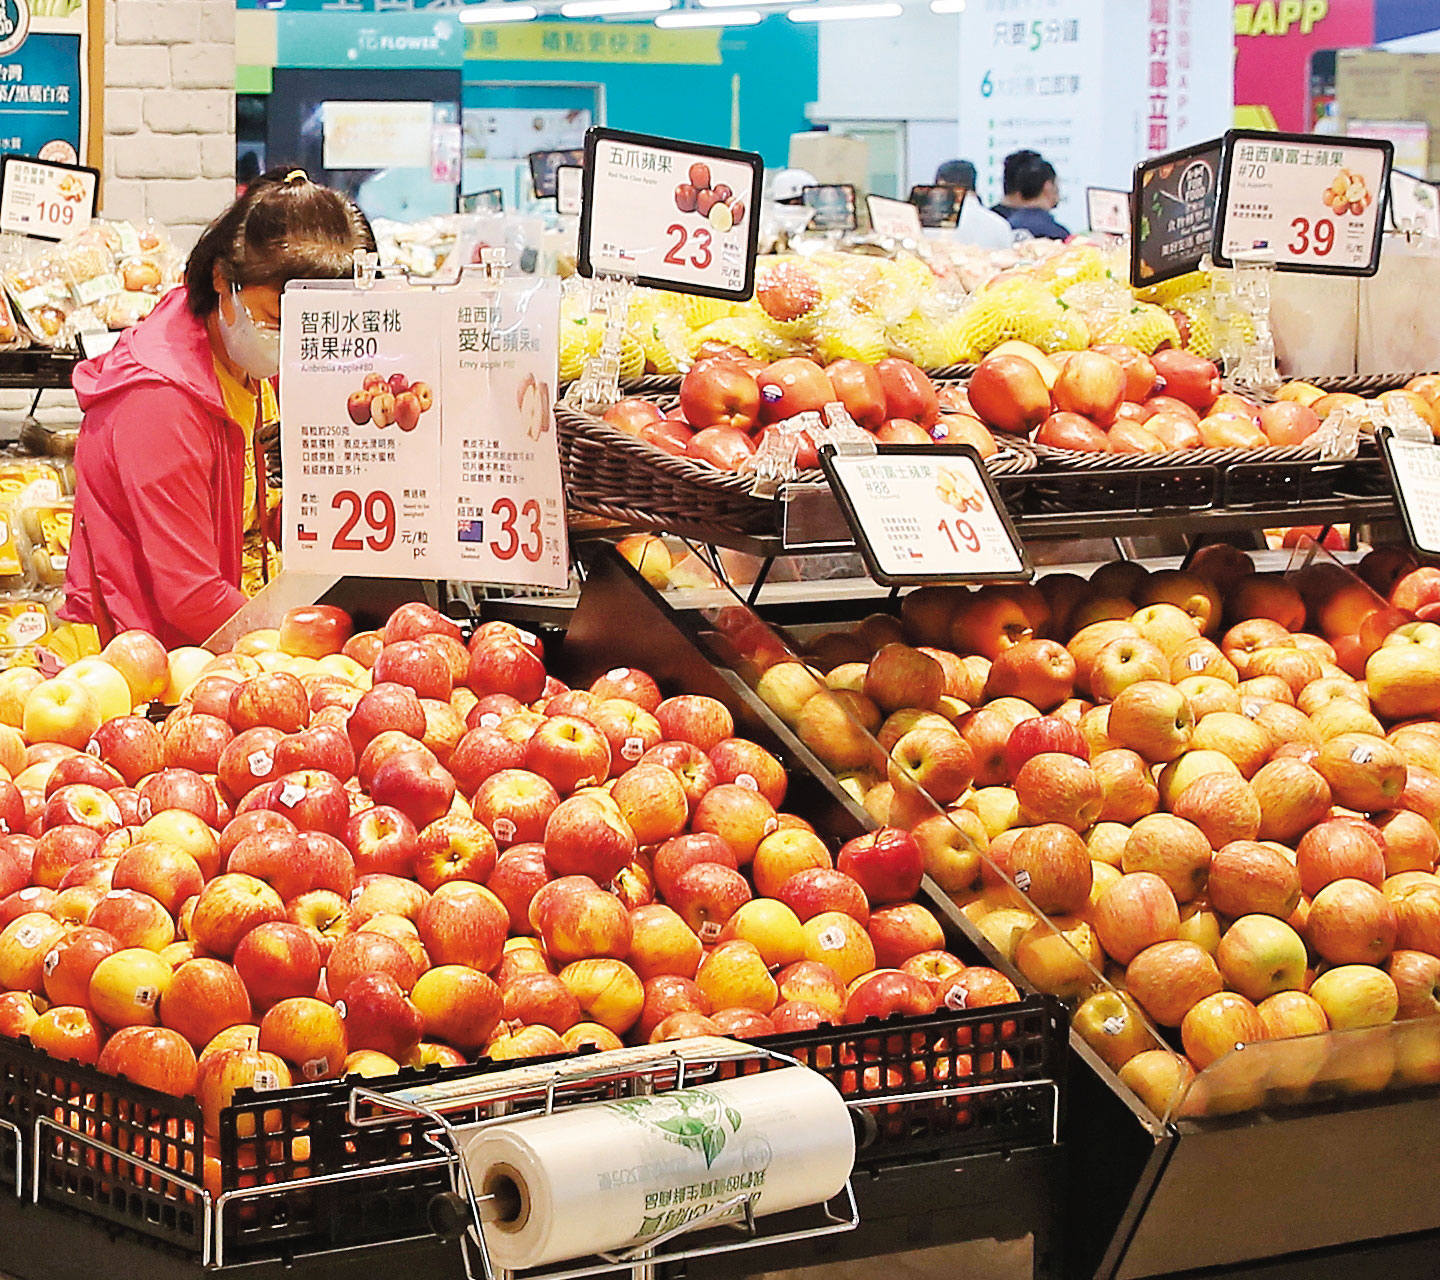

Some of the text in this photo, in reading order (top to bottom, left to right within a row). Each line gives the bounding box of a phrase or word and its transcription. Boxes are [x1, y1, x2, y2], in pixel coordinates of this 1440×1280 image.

[380, 35, 440, 51] FLOWER
[609, 147, 673, 174] 五爪蘋果
[1240, 145, 1344, 167] 紐西蘭富士蘋果
[1238, 164, 1266, 179] #70
[36, 201, 74, 225] 109
[663, 223, 712, 269] 23
[1288, 217, 1335, 256] 39
[301, 309, 402, 334] 智利水蜜桃
[301, 337, 378, 361] 蘋果#80
[331, 490, 396, 552] 29
[490, 497, 544, 562] 33
[401, 531, 429, 544] 元/粒
[937, 517, 981, 554] 19
[412, 547, 427, 560] pc
